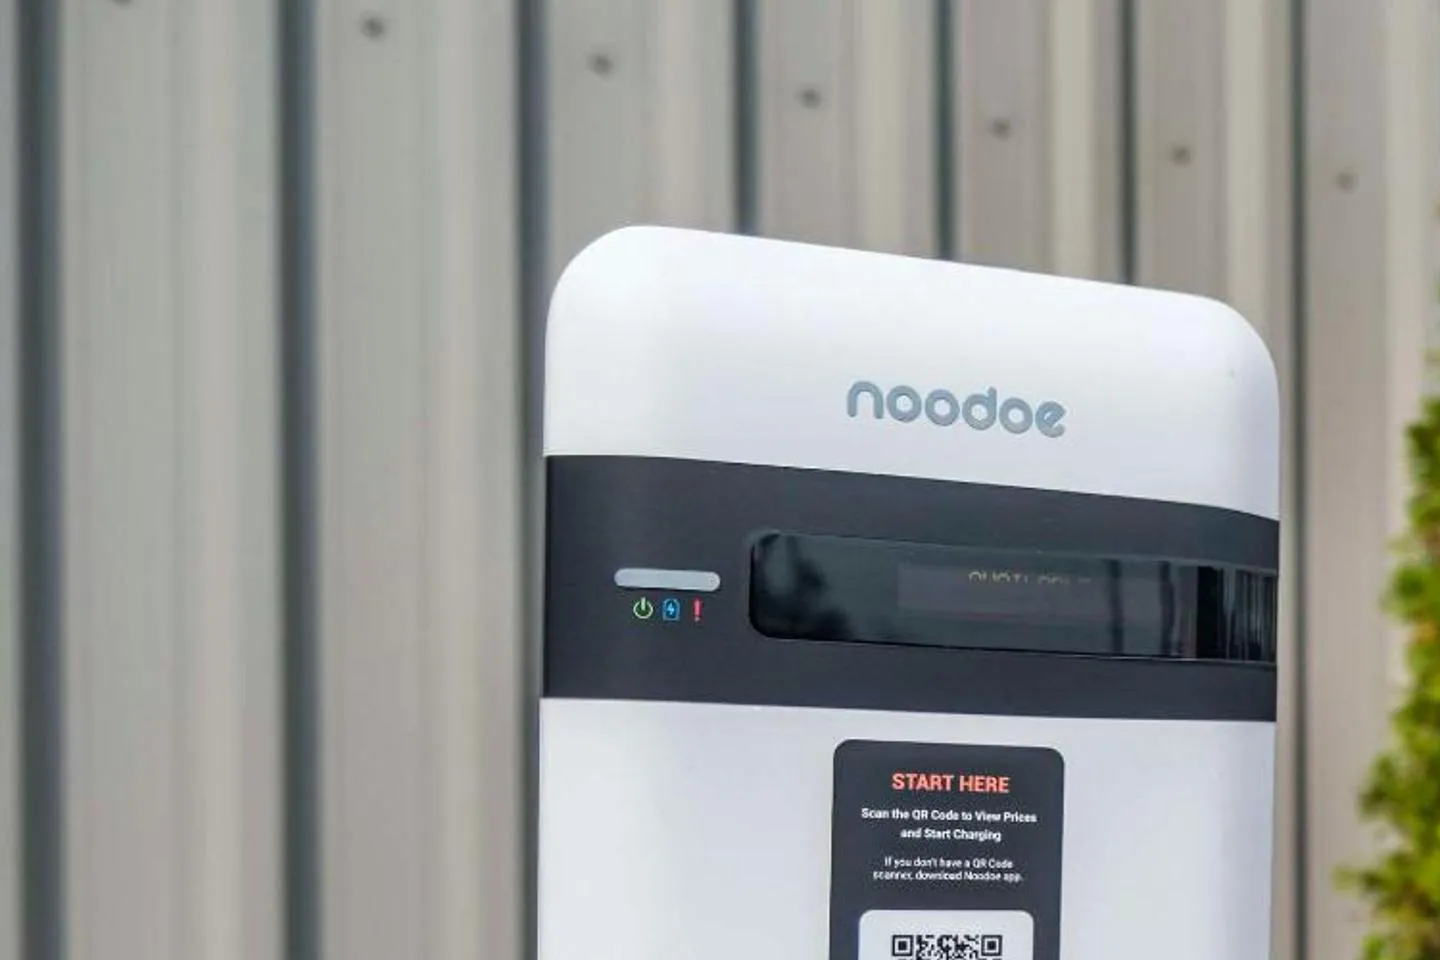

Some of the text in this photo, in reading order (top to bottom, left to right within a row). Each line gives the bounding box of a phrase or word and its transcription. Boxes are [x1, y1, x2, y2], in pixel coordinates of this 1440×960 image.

[846, 380, 1067, 439] noodoe
[891, 772, 1011, 793] START HERE
[861, 807, 1038, 823] Scan the QR Code to View Prices
[900, 827, 1002, 843] and Start Charging
[884, 856, 1014, 869] If you don't have a QR Code
[872, 869, 1023, 883] scanner, download Noodoe app.
